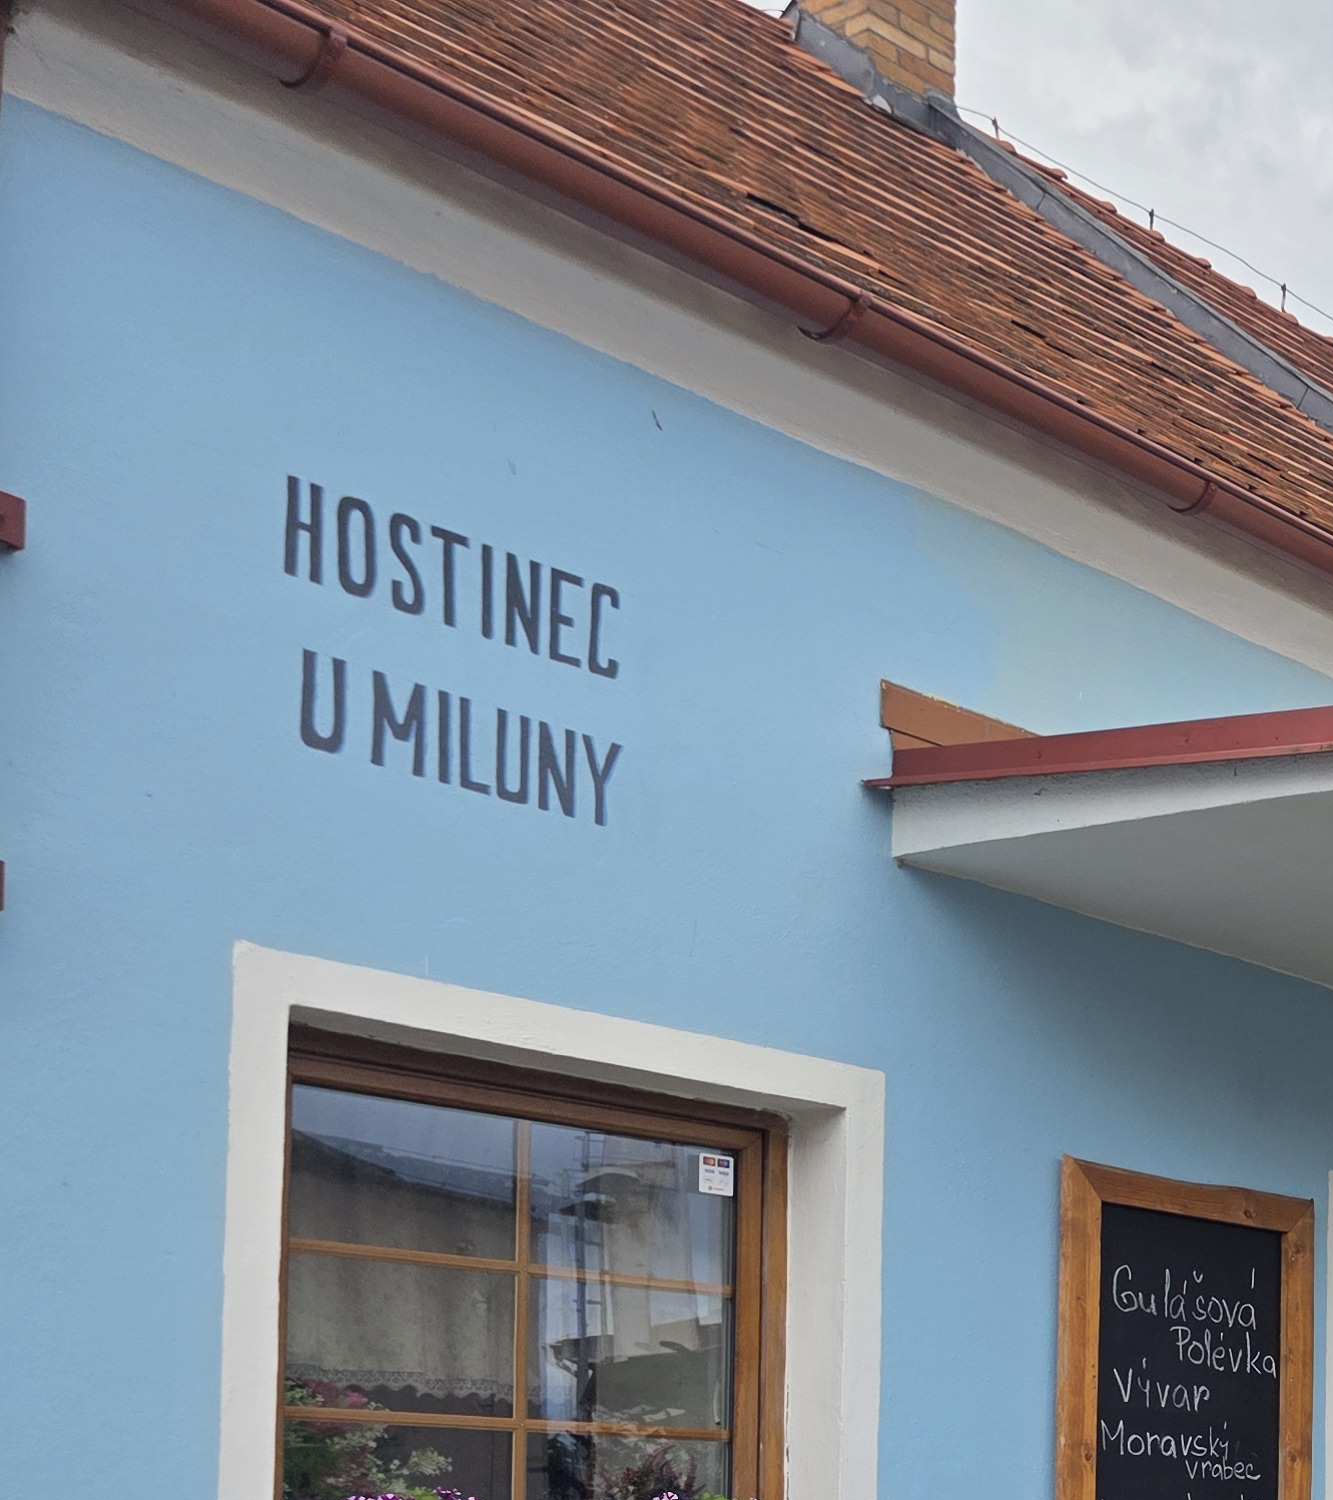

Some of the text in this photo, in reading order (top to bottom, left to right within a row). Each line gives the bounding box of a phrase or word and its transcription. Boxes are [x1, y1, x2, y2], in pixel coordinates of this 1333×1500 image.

[284, 475, 620, 680] HOSTINEC
[300, 648, 624, 827] U MILUNY
